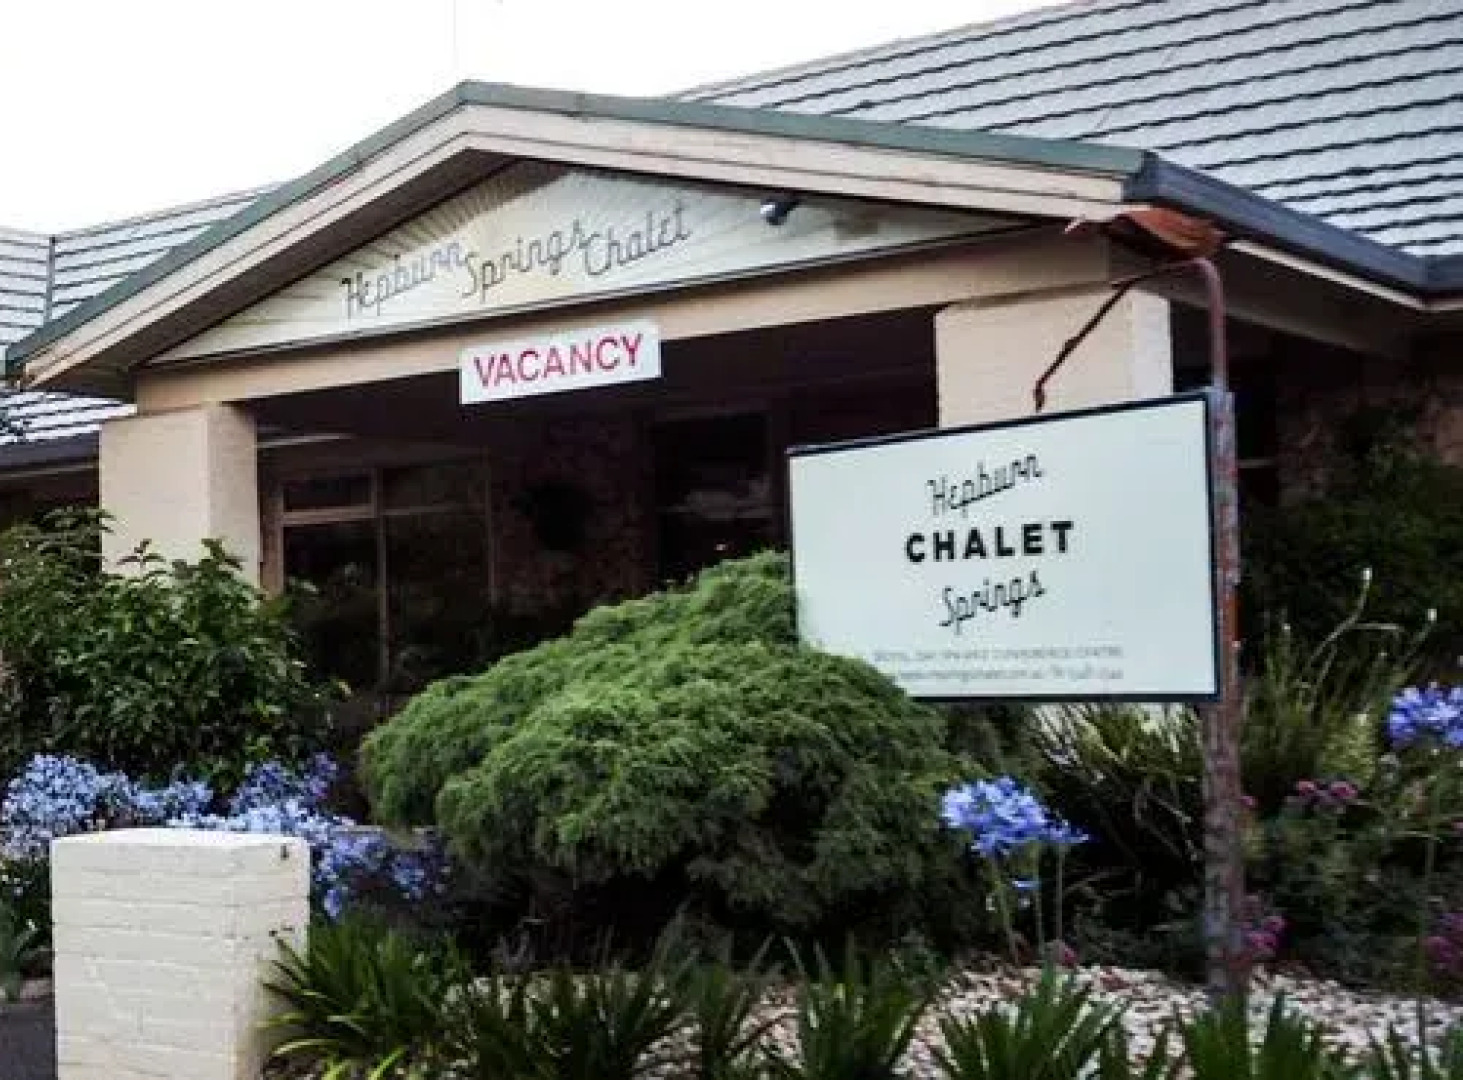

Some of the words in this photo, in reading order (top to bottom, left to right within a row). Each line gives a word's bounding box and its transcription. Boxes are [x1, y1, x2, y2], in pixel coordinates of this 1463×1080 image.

[339, 242, 466, 318] Hepburn
[462, 218, 588, 301] Springs
[584, 199, 692, 276] Chalet
[473, 332, 643, 387] VACANCY
[926, 453, 1044, 518] Hepburn
[905, 520, 1074, 563] CHALET
[937, 570, 1045, 636] Springs
